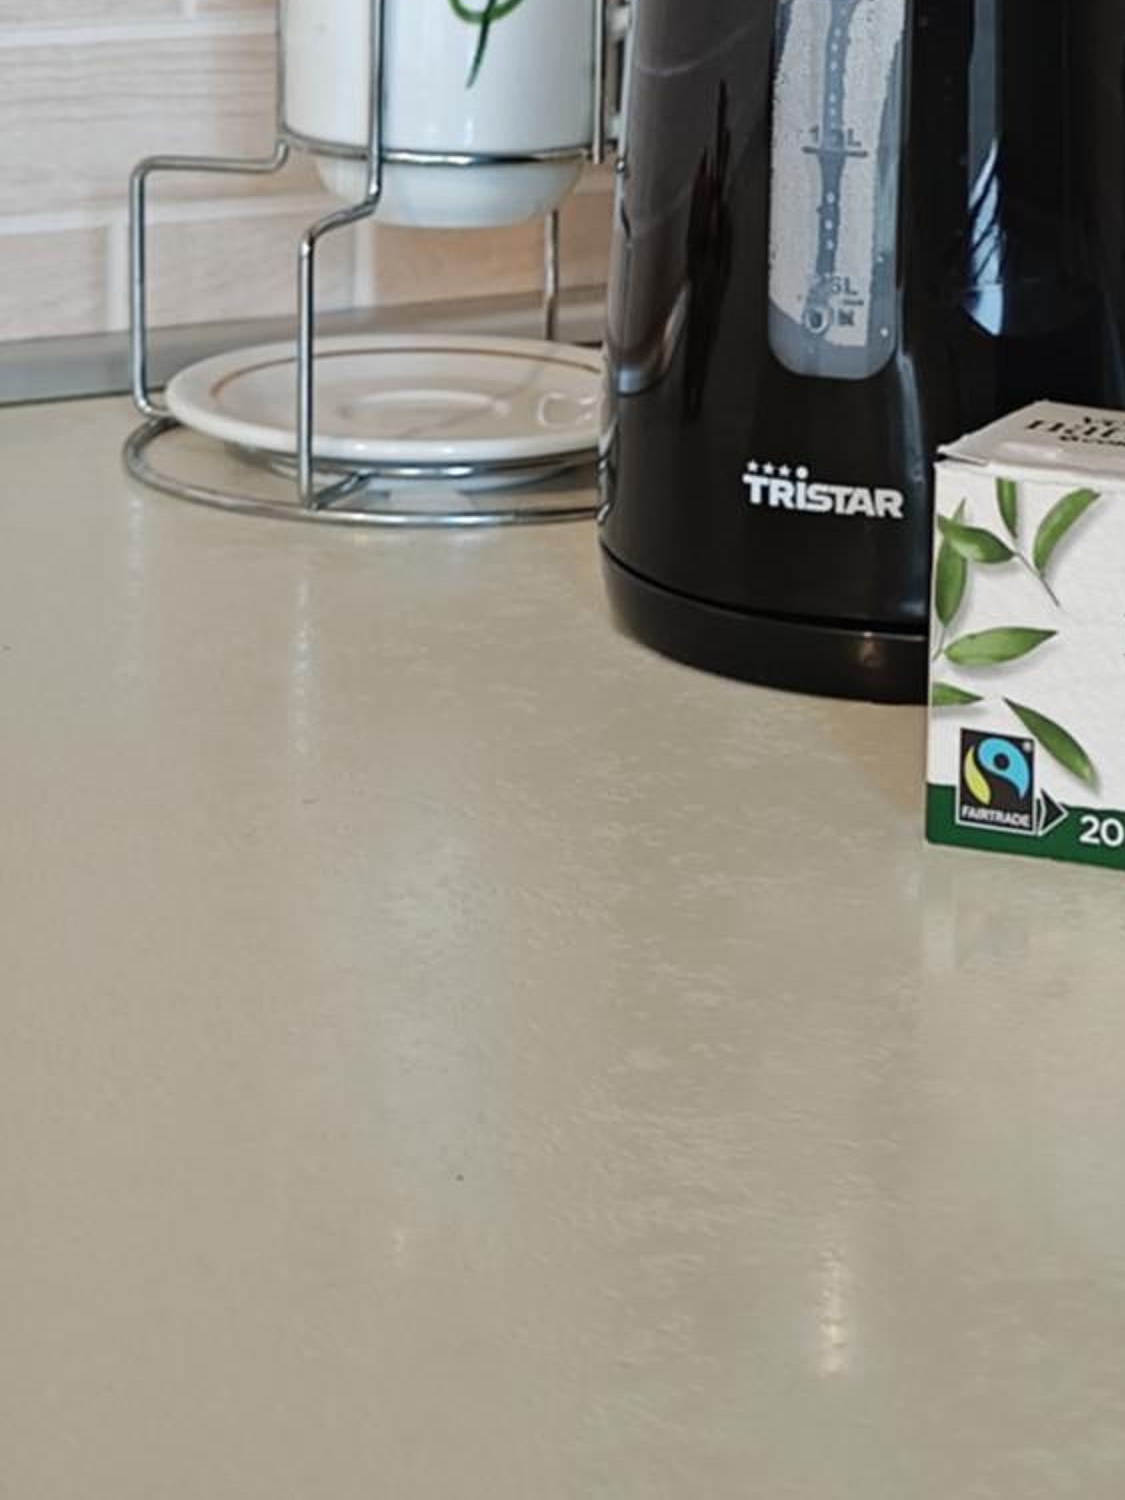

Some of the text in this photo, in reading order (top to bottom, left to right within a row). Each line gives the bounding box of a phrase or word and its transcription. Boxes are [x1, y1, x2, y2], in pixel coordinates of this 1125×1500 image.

[742, 465, 904, 519] TRISTAR
[961, 804, 1031, 829] FAIRTRADE
[1079, 814, 1125, 848] 20
